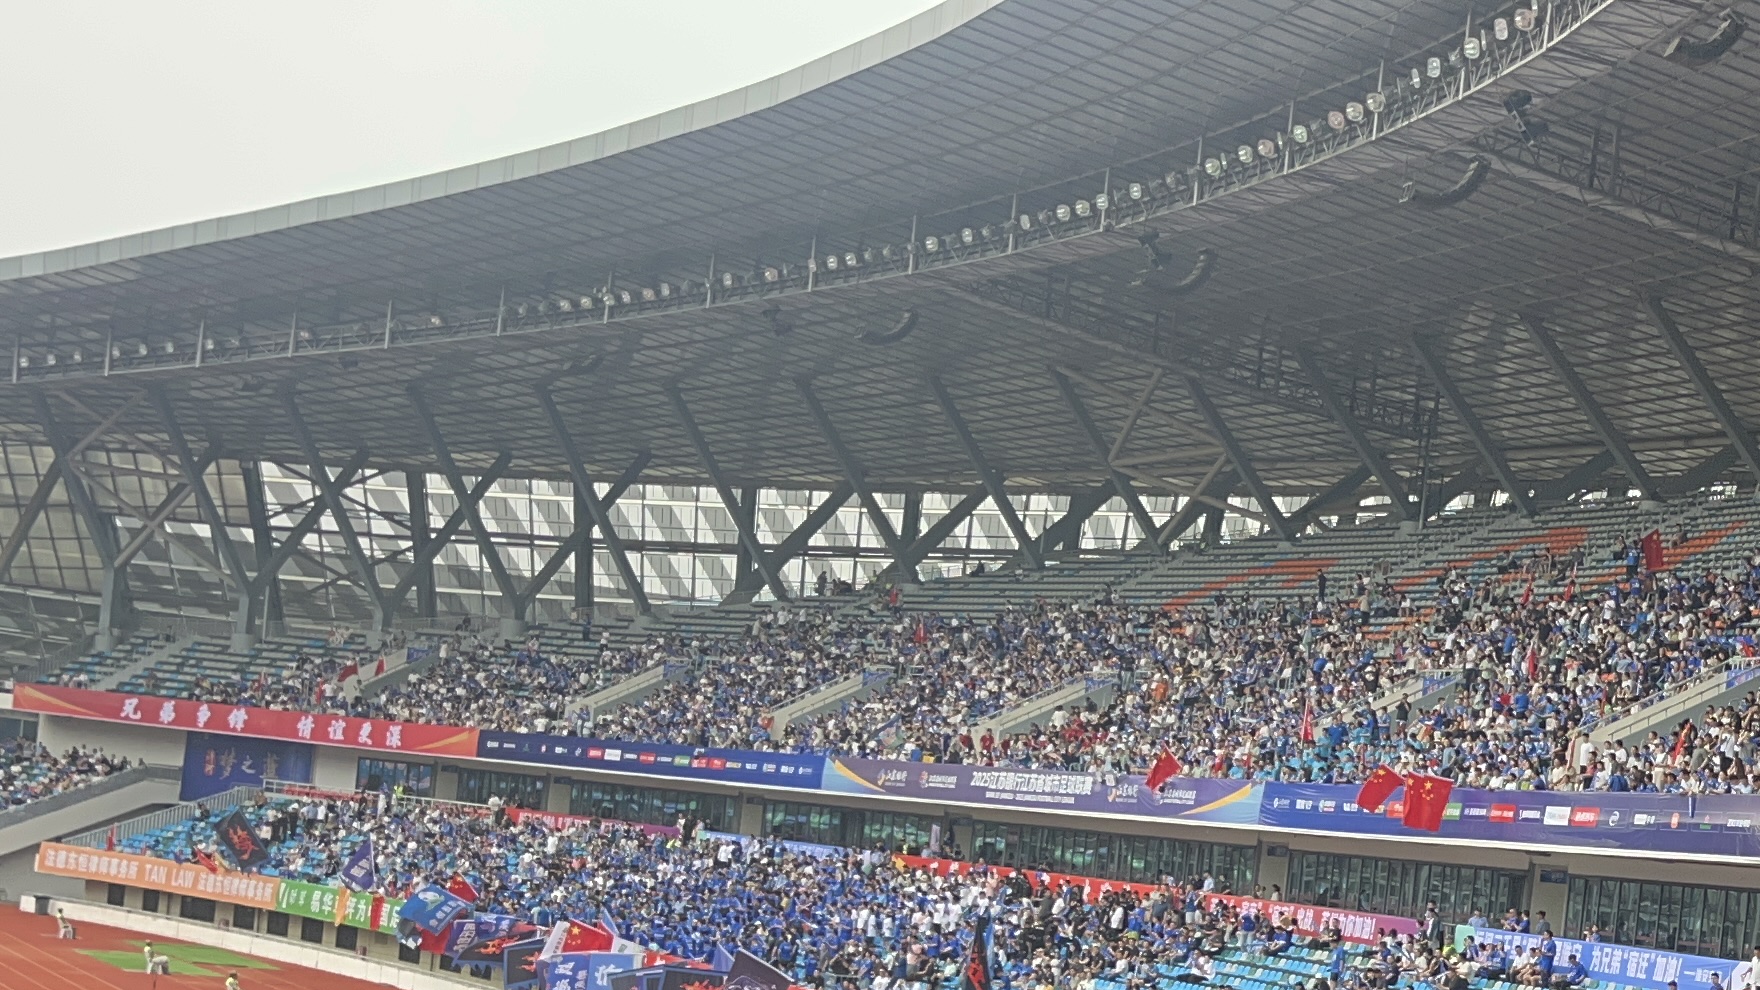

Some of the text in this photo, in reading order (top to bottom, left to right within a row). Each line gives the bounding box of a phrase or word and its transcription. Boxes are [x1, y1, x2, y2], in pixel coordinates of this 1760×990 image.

[120, 697, 248, 732] 兄弟争锋
[171, 868, 196, 888] LAW
